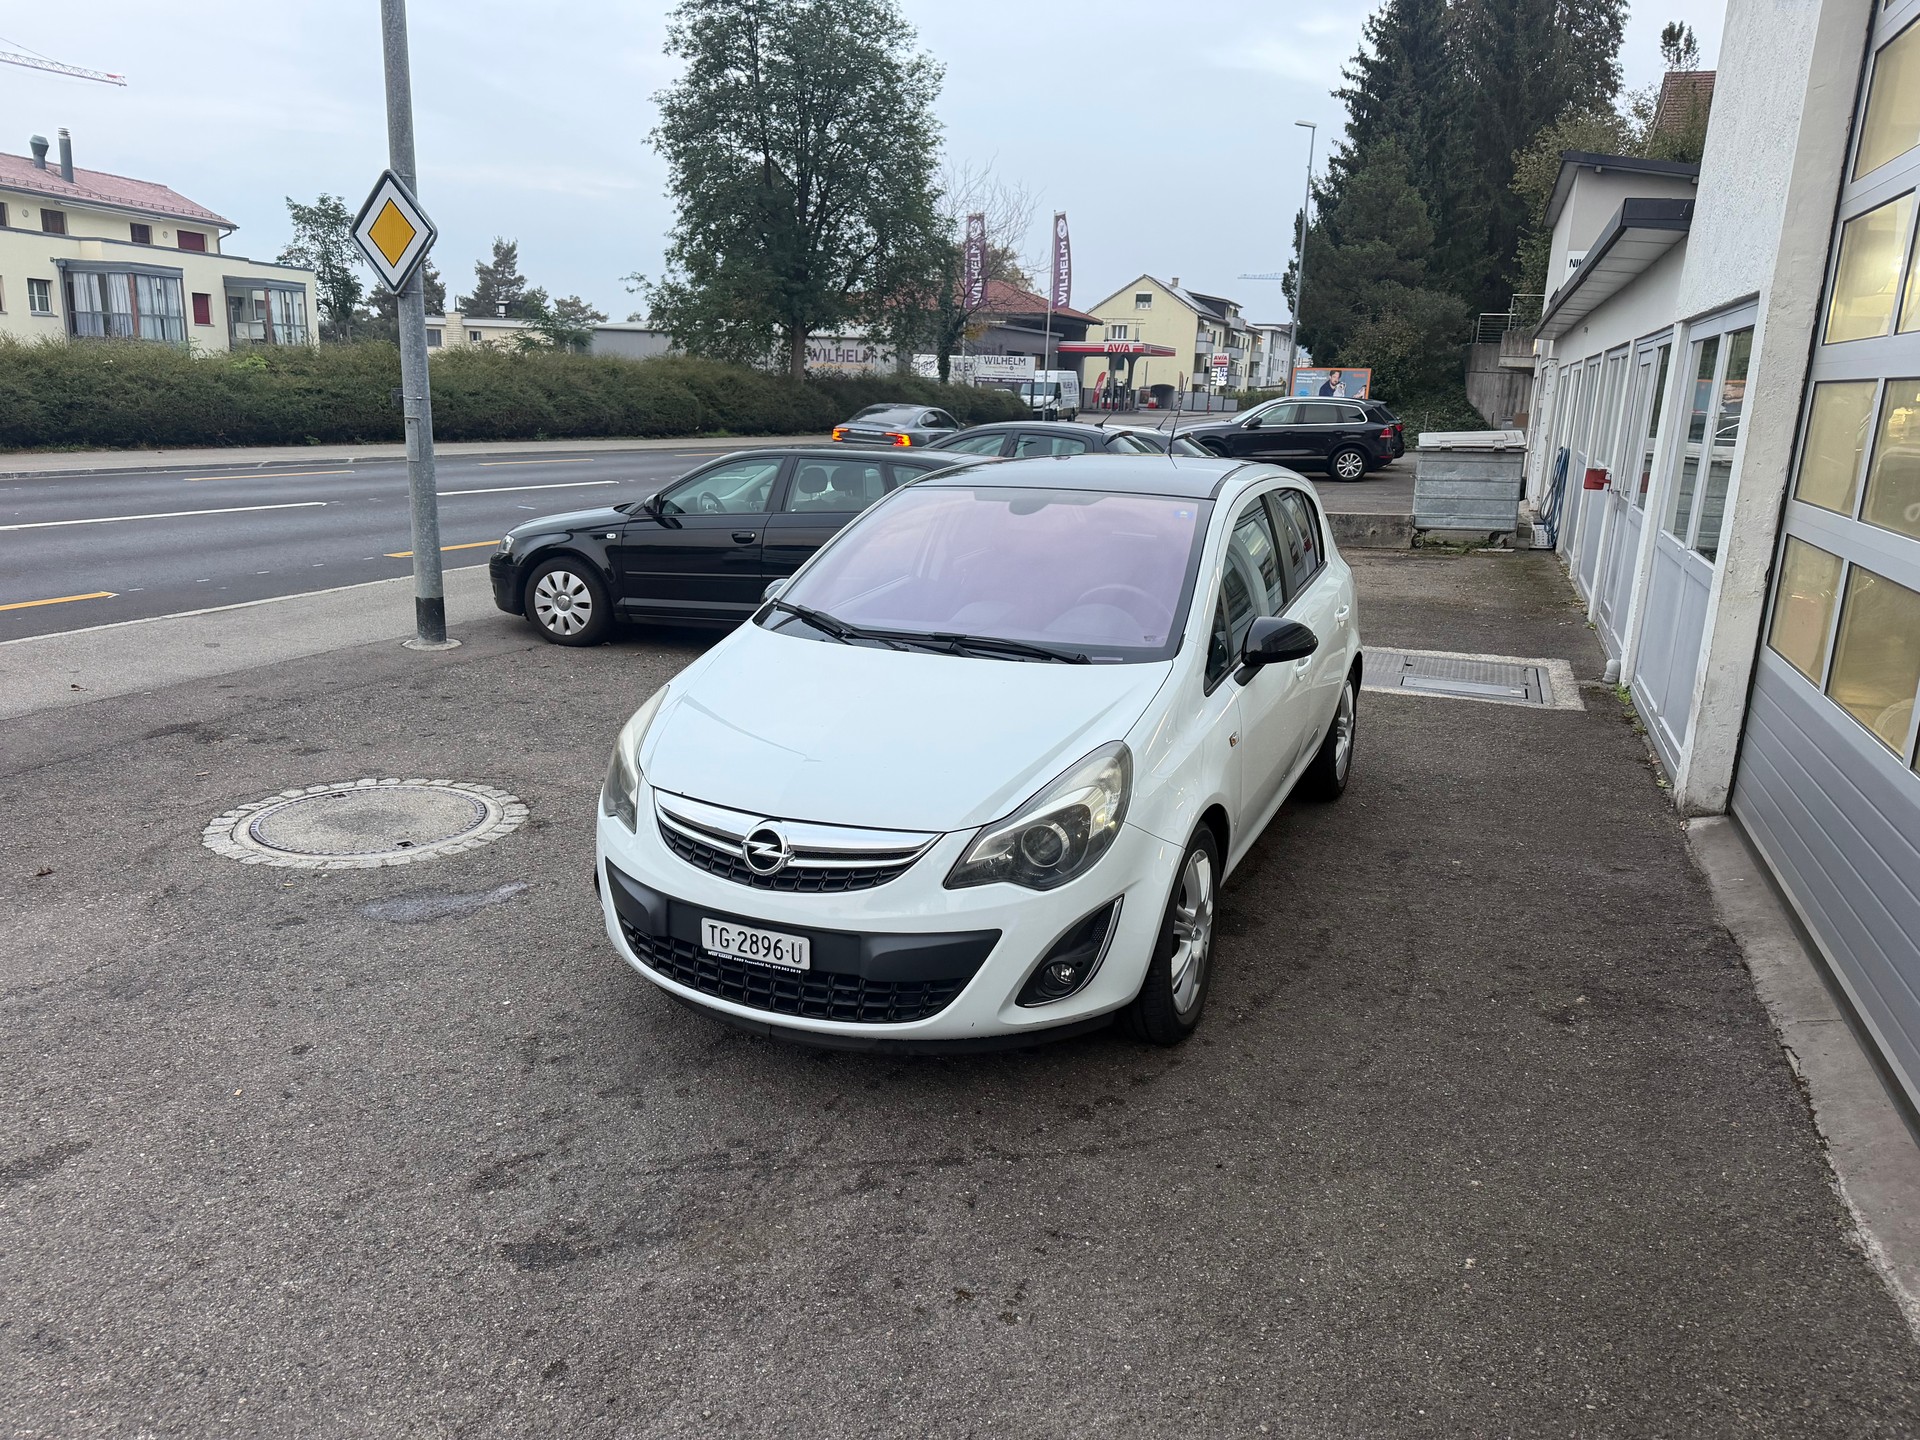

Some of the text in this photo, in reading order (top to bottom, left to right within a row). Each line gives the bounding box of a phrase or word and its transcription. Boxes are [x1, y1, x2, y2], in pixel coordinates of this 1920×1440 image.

[1057, 241, 1069, 306] WILHELM
[1107, 343, 1130, 352] AVIA
[808, 347, 875, 363] WILHELM
[983, 356, 1026, 366] WILHELM
